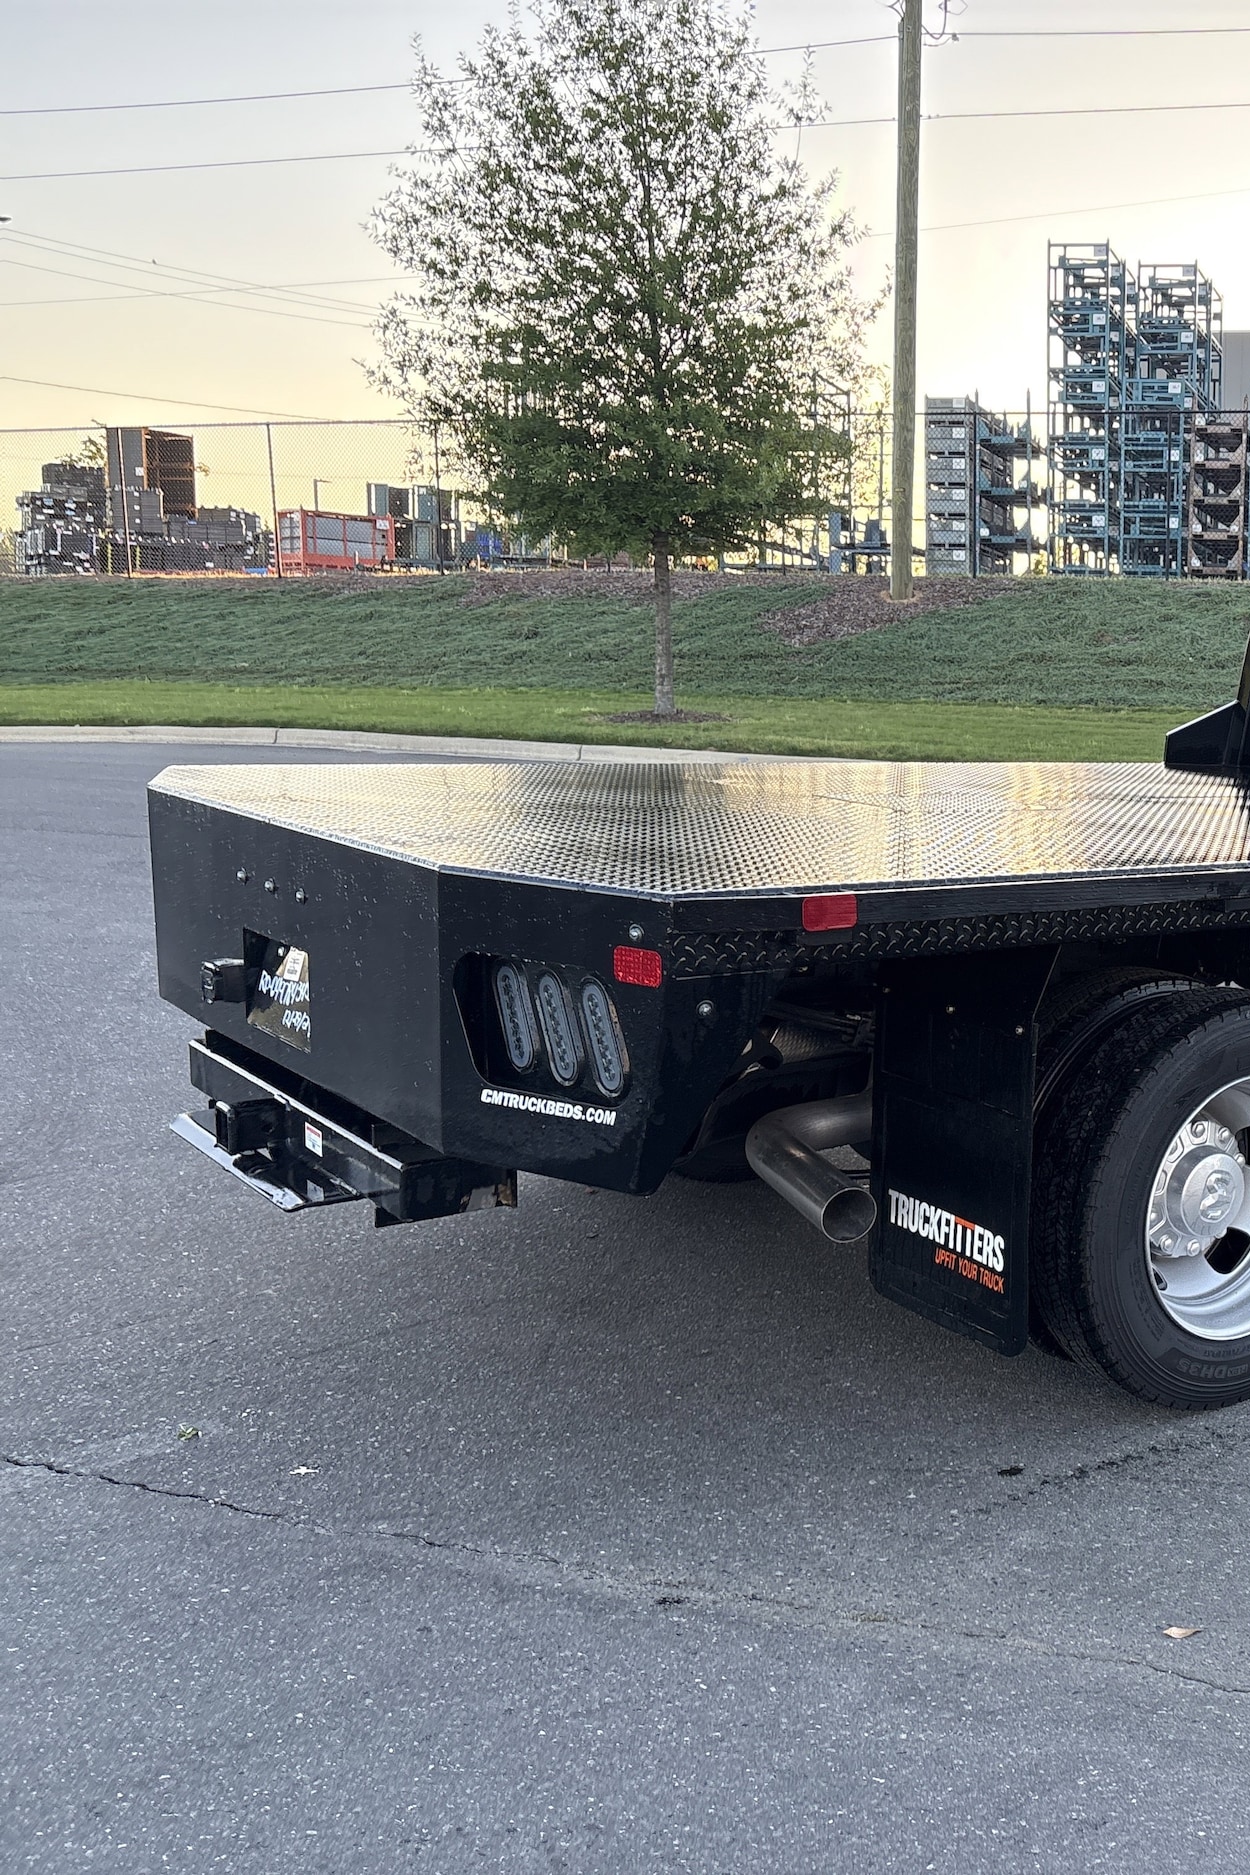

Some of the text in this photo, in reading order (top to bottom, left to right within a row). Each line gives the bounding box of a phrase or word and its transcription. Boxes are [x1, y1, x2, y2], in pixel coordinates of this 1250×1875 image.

[481, 1089, 616, 1126] CMTRUCKBEDS.COM
[888, 1188, 1005, 1272] TRUCKFITTERS
[935, 1247, 1005, 1294] UPFIT YOUR TRUCK
[1177, 1358, 1227, 1379] DH35
